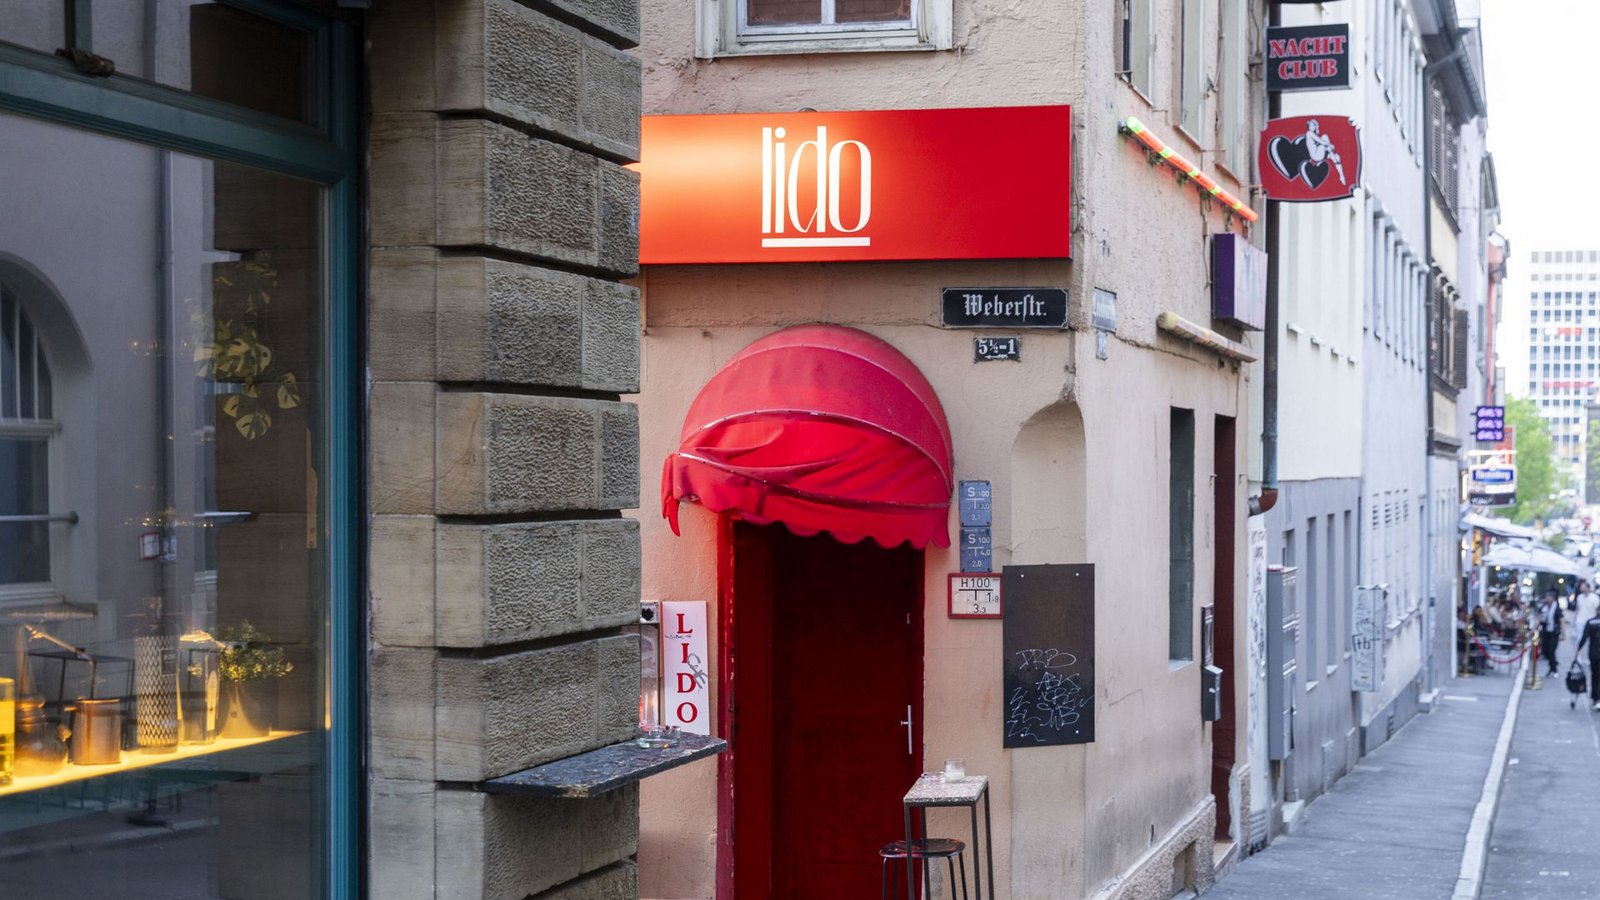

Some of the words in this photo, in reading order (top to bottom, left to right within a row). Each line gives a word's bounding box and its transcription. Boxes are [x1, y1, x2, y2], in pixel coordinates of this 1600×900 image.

[1269, 36, 1346, 58] NACHT
[1278, 59, 1337, 79] CLUB
[761, 126, 872, 233] lido
[967, 487, 976, 497] S
[968, 534, 976, 544] S
